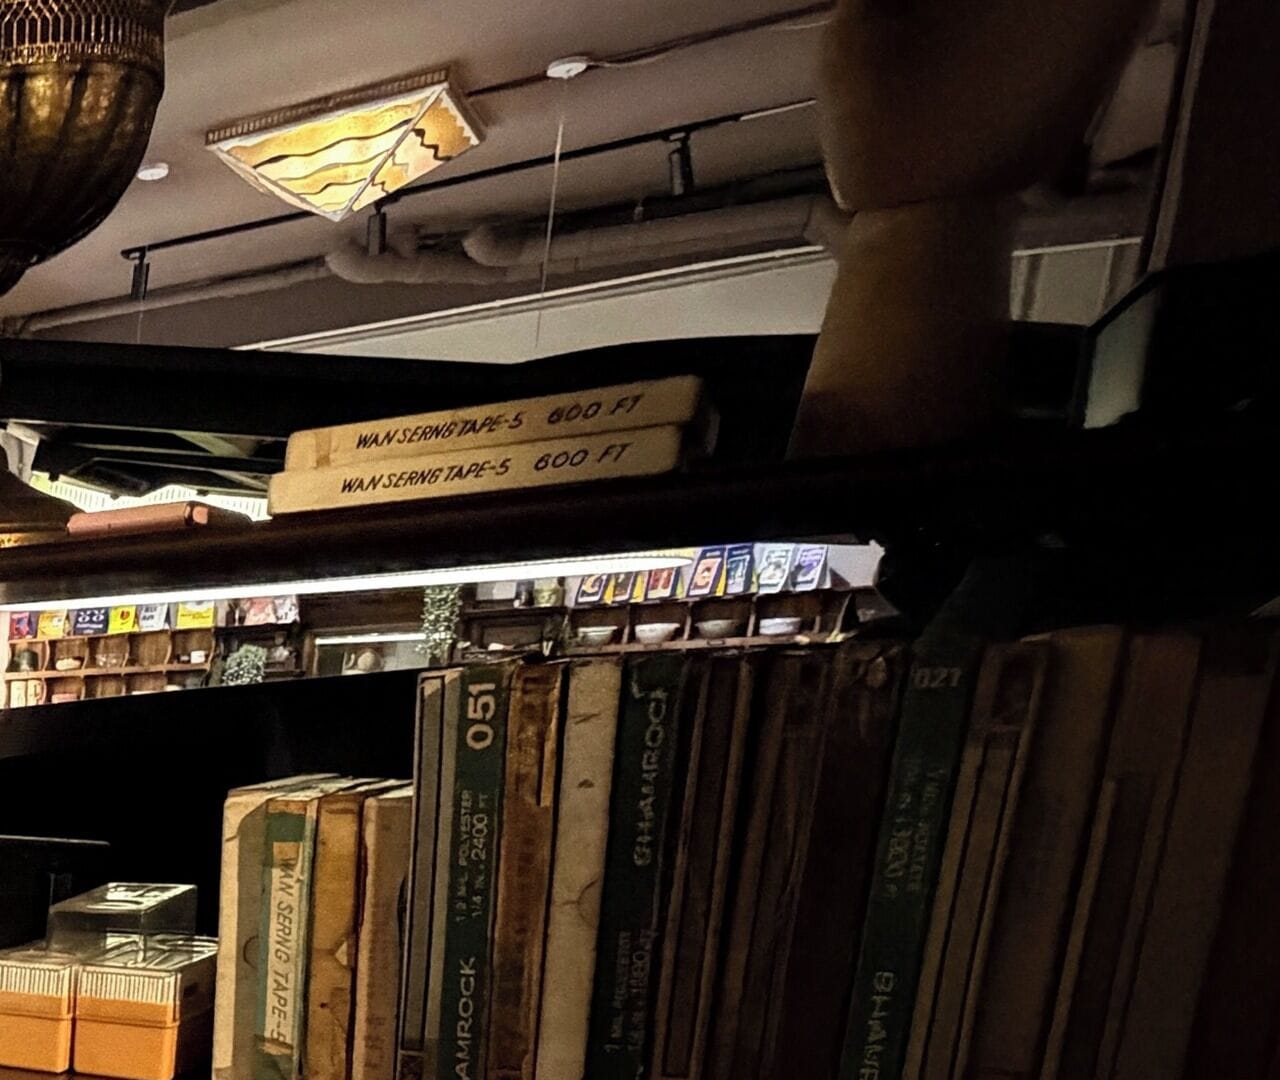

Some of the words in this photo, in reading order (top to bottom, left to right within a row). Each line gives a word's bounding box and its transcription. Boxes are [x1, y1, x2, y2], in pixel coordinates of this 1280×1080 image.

[356, 428, 399, 449] WAN
[548, 402, 602, 424] 600
[609, 394, 645, 415] FT
[341, 474, 384, 494] WAN
[534, 448, 589, 471] 600
[597, 442, 634, 463] FT
[466, 683, 496, 750] 051
[471, 813, 488, 861] 2400
[274, 900, 293, 963] SERNG
